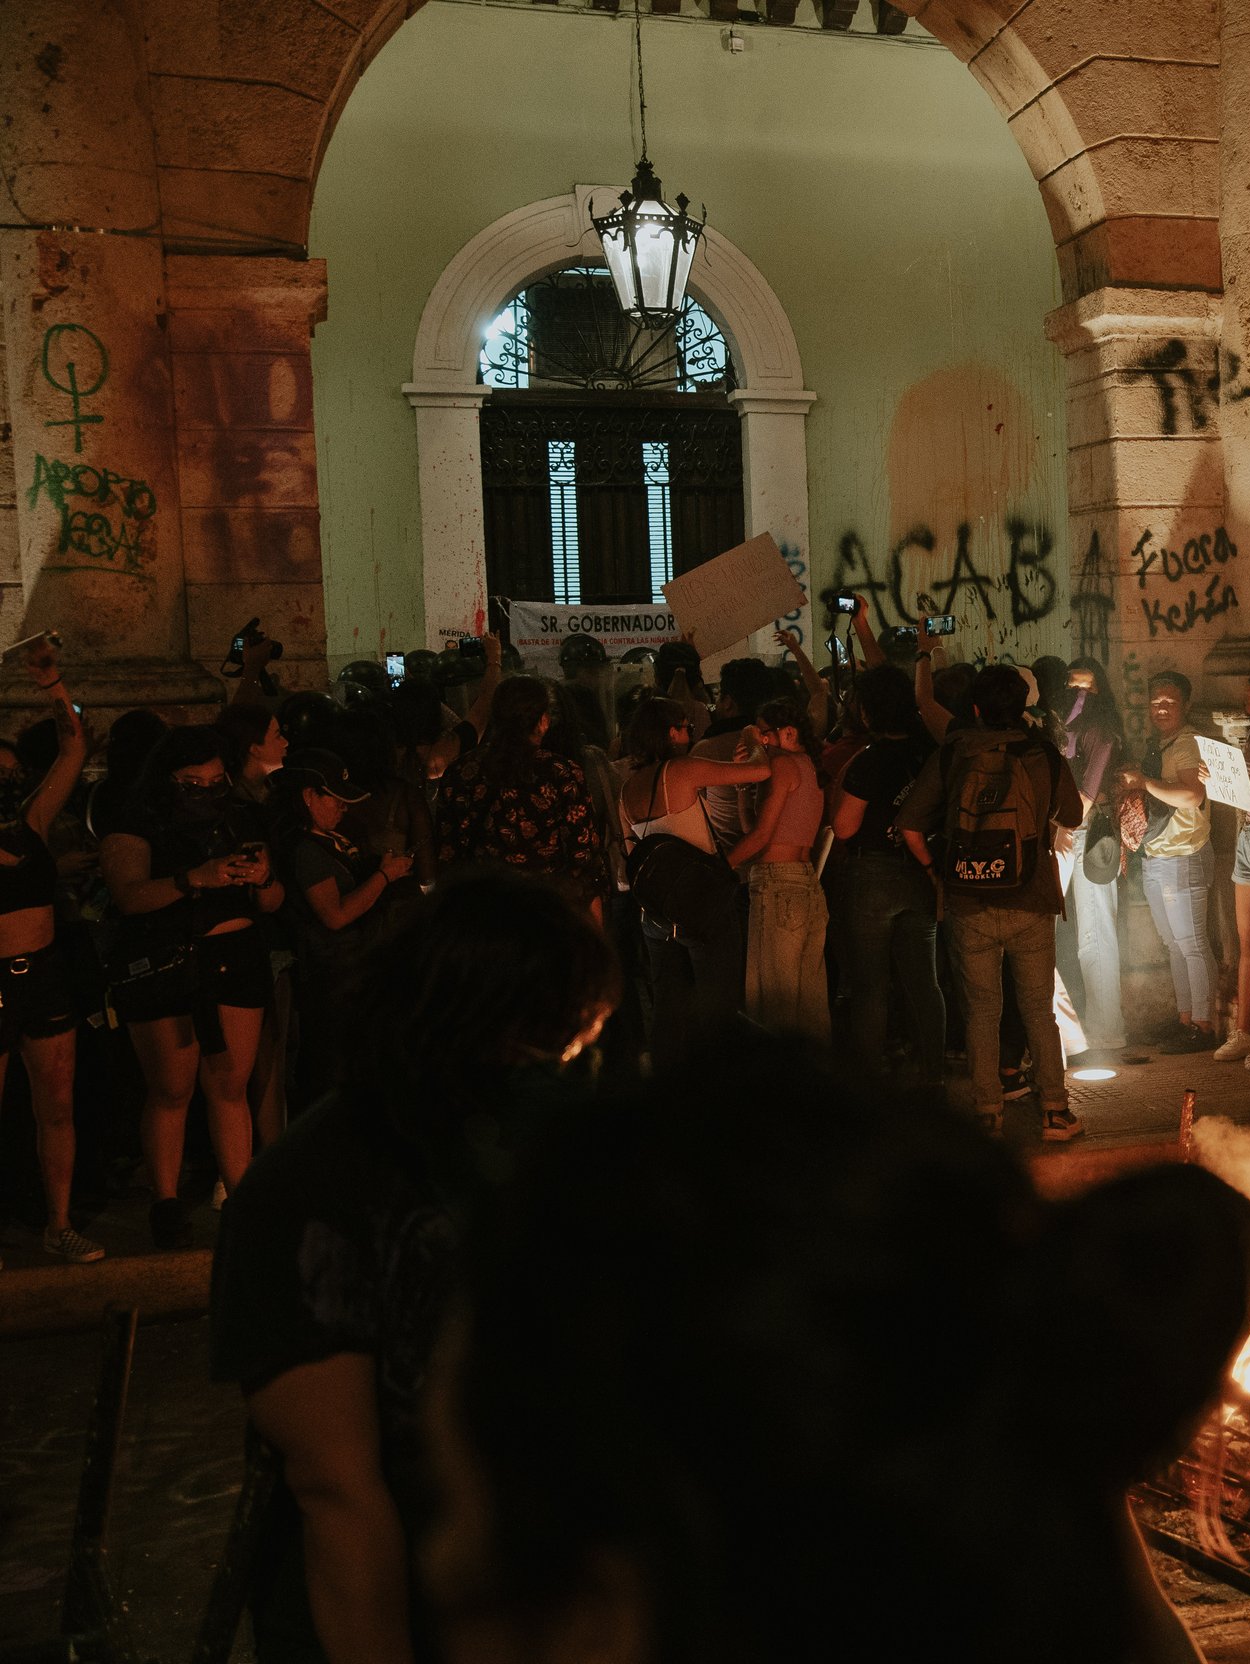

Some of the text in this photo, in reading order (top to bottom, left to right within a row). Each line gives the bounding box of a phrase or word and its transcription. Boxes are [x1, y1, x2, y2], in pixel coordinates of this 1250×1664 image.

[820, 521, 1056, 632] ACAB
[540, 613, 676, 633] SR. GOBERNADOR
[609, 637, 636, 645] CONTRA
